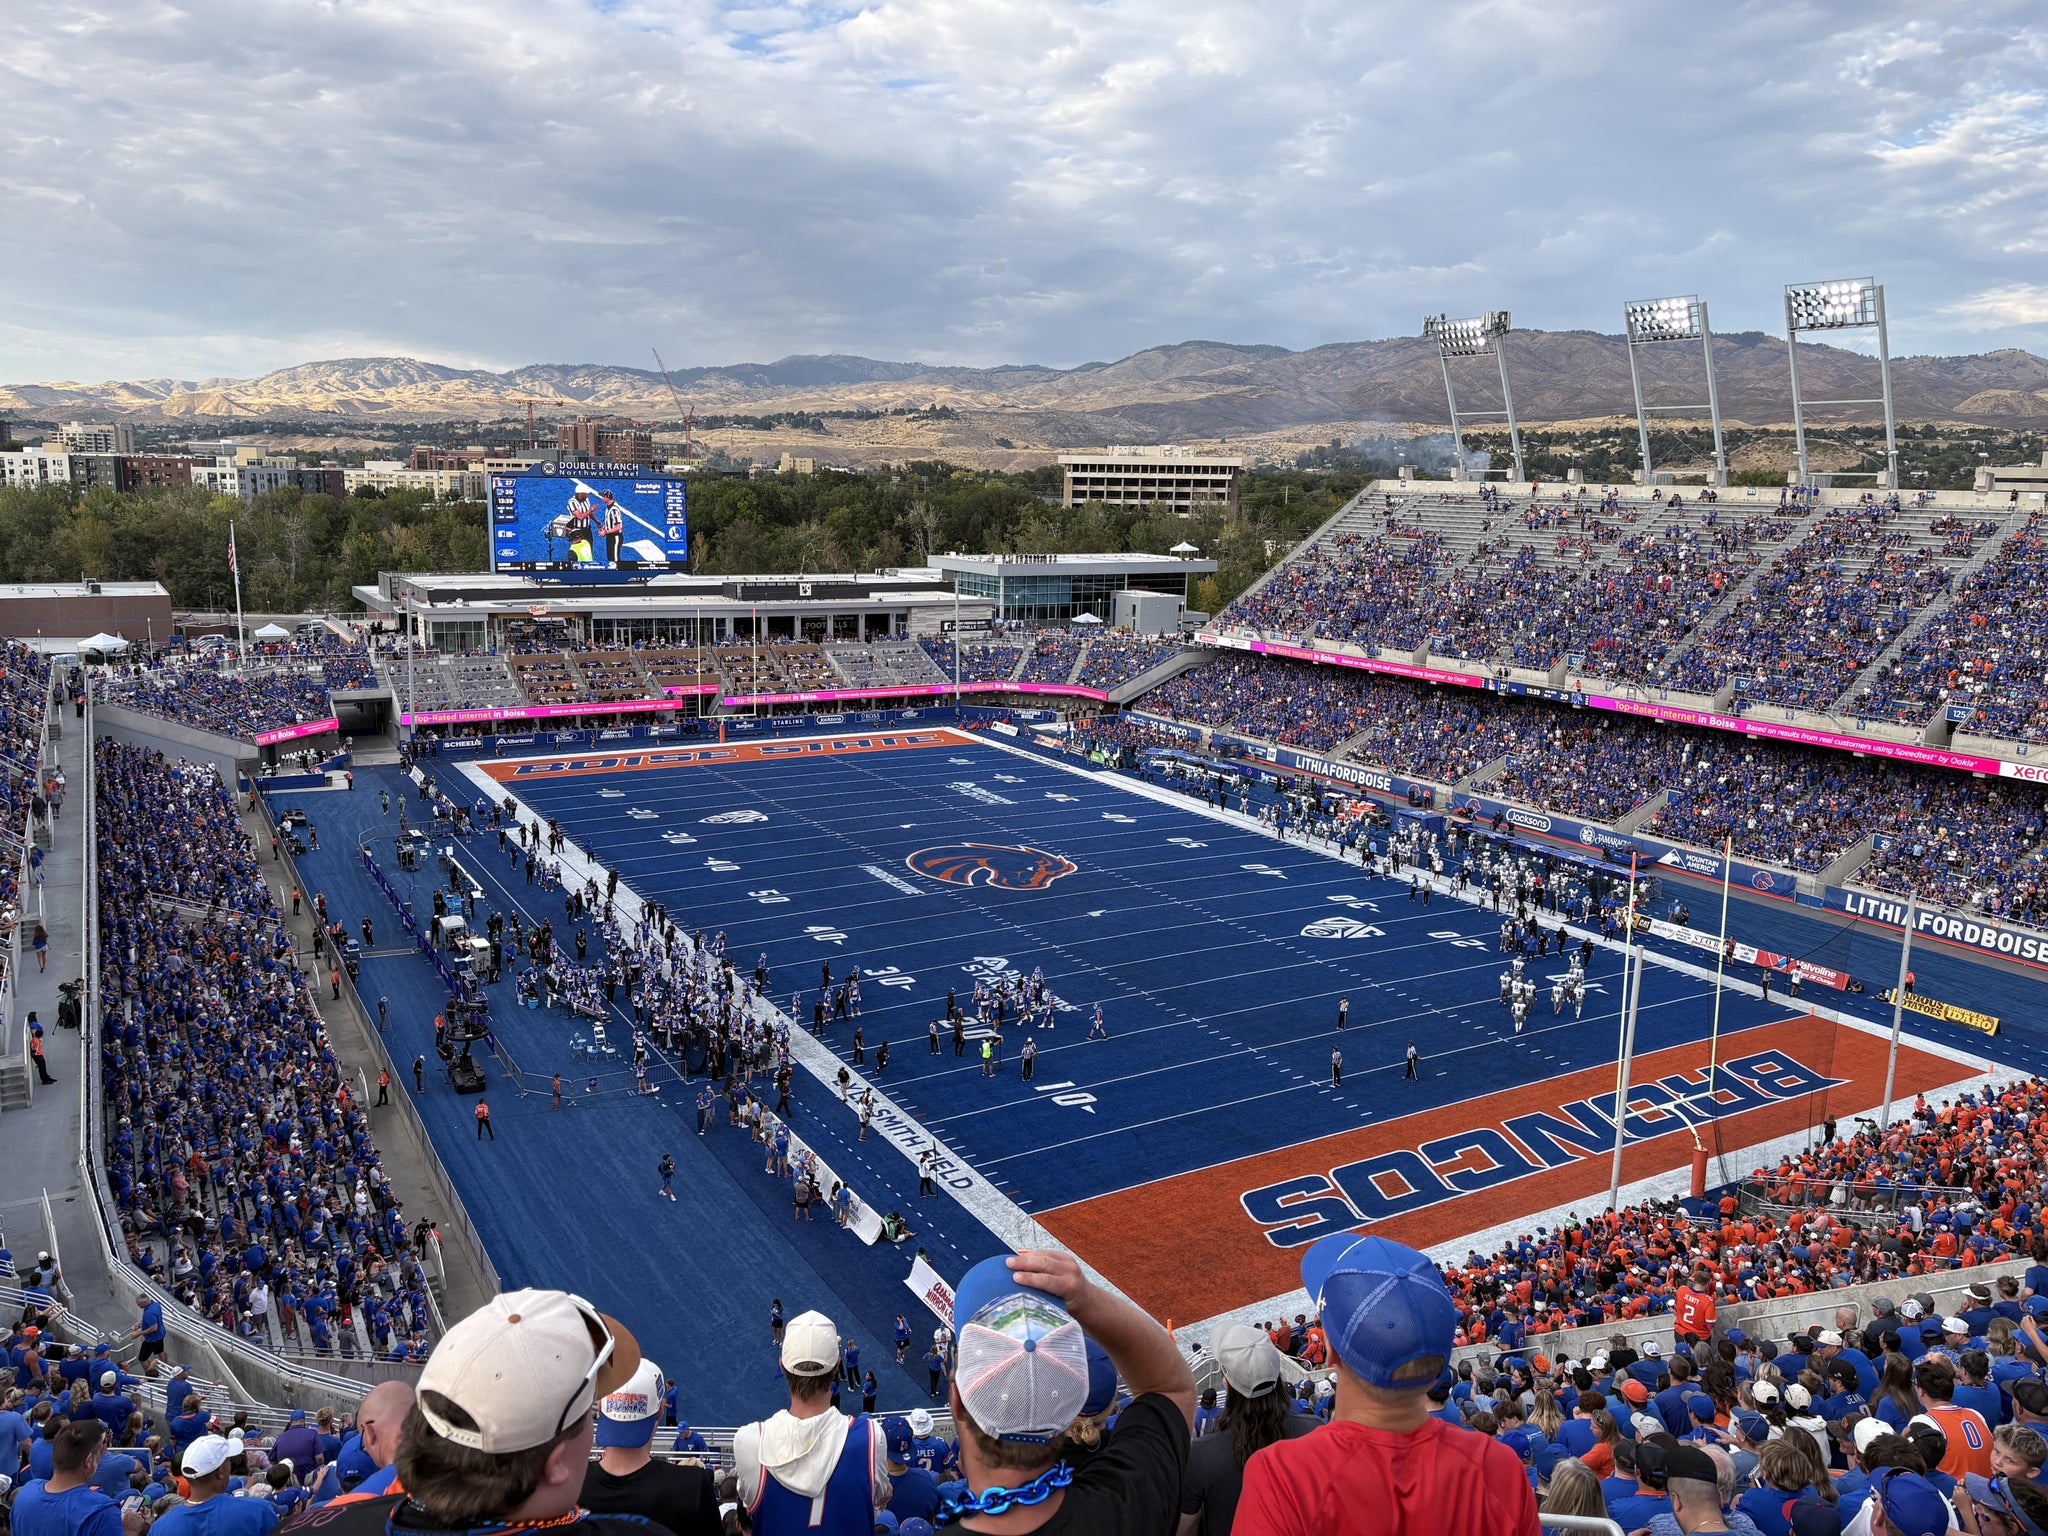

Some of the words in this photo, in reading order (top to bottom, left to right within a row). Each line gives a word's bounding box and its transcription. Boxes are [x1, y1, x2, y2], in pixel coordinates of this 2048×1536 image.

[559, 462, 596, 470] DOUBLE
[599, 462, 605, 470] R
[607, 462, 639, 470] RANCH
[1266, 645, 1292, 654] Top-Rated
[1292, 649, 1313, 658] Internet
[1320, 654, 1337, 664] Boise.
[1526, 687, 1541, 695] 13:39
[414, 712, 457, 723] Top-Rated
[459, 711, 491, 720] Internet
[503, 709, 528, 717] Boise.
[1615, 701, 1658, 716] Top-Rated
[1661, 709, 1696, 722] Internet
[1698, 715, 1706, 724] in
[1708, 717, 1738, 729] Boise.
[1953, 709, 1966, 718] 125
[1745, 724, 1767, 734] Based
[1777, 729, 1800, 739] results
[1800, 731, 1819, 743] from
[1819, 735, 1834, 745] real
[1834, 739, 1872, 751] customers
[1872, 745, 1894, 756] using
[1938, 753, 1950, 764] by
[507, 749, 739, 776] BOISE
[753, 734, 945, 757] STATE
[1295, 755, 1392, 791] LITHIAFORDBOISE
[1511, 812, 1547, 829] Jacksons
[1685, 853, 1720, 868] MOUNTAIN
[1686, 861, 1716, 874] AMERICA
[747, 889, 791, 904] 50
[1326, 895, 1378, 911] 30
[1638, 919, 1651, 929] CAT
[802, 925, 849, 943] 40
[1427, 931, 1487, 949] 20
[863, 965, 917, 988] 30
[1796, 960, 1837, 979] Valvoline
[1945, 1009, 1992, 1031] IDAHO
[1033, 1080, 1098, 1108] 10
[872, 1108, 926, 1148] SMITH
[1239, 1049, 1854, 1248] BRONCOS
[925, 1289, 946, 1314] MIRROR
[1683, 1304, 1695, 1325] 2
[1959, 1420, 1984, 1450] 0
